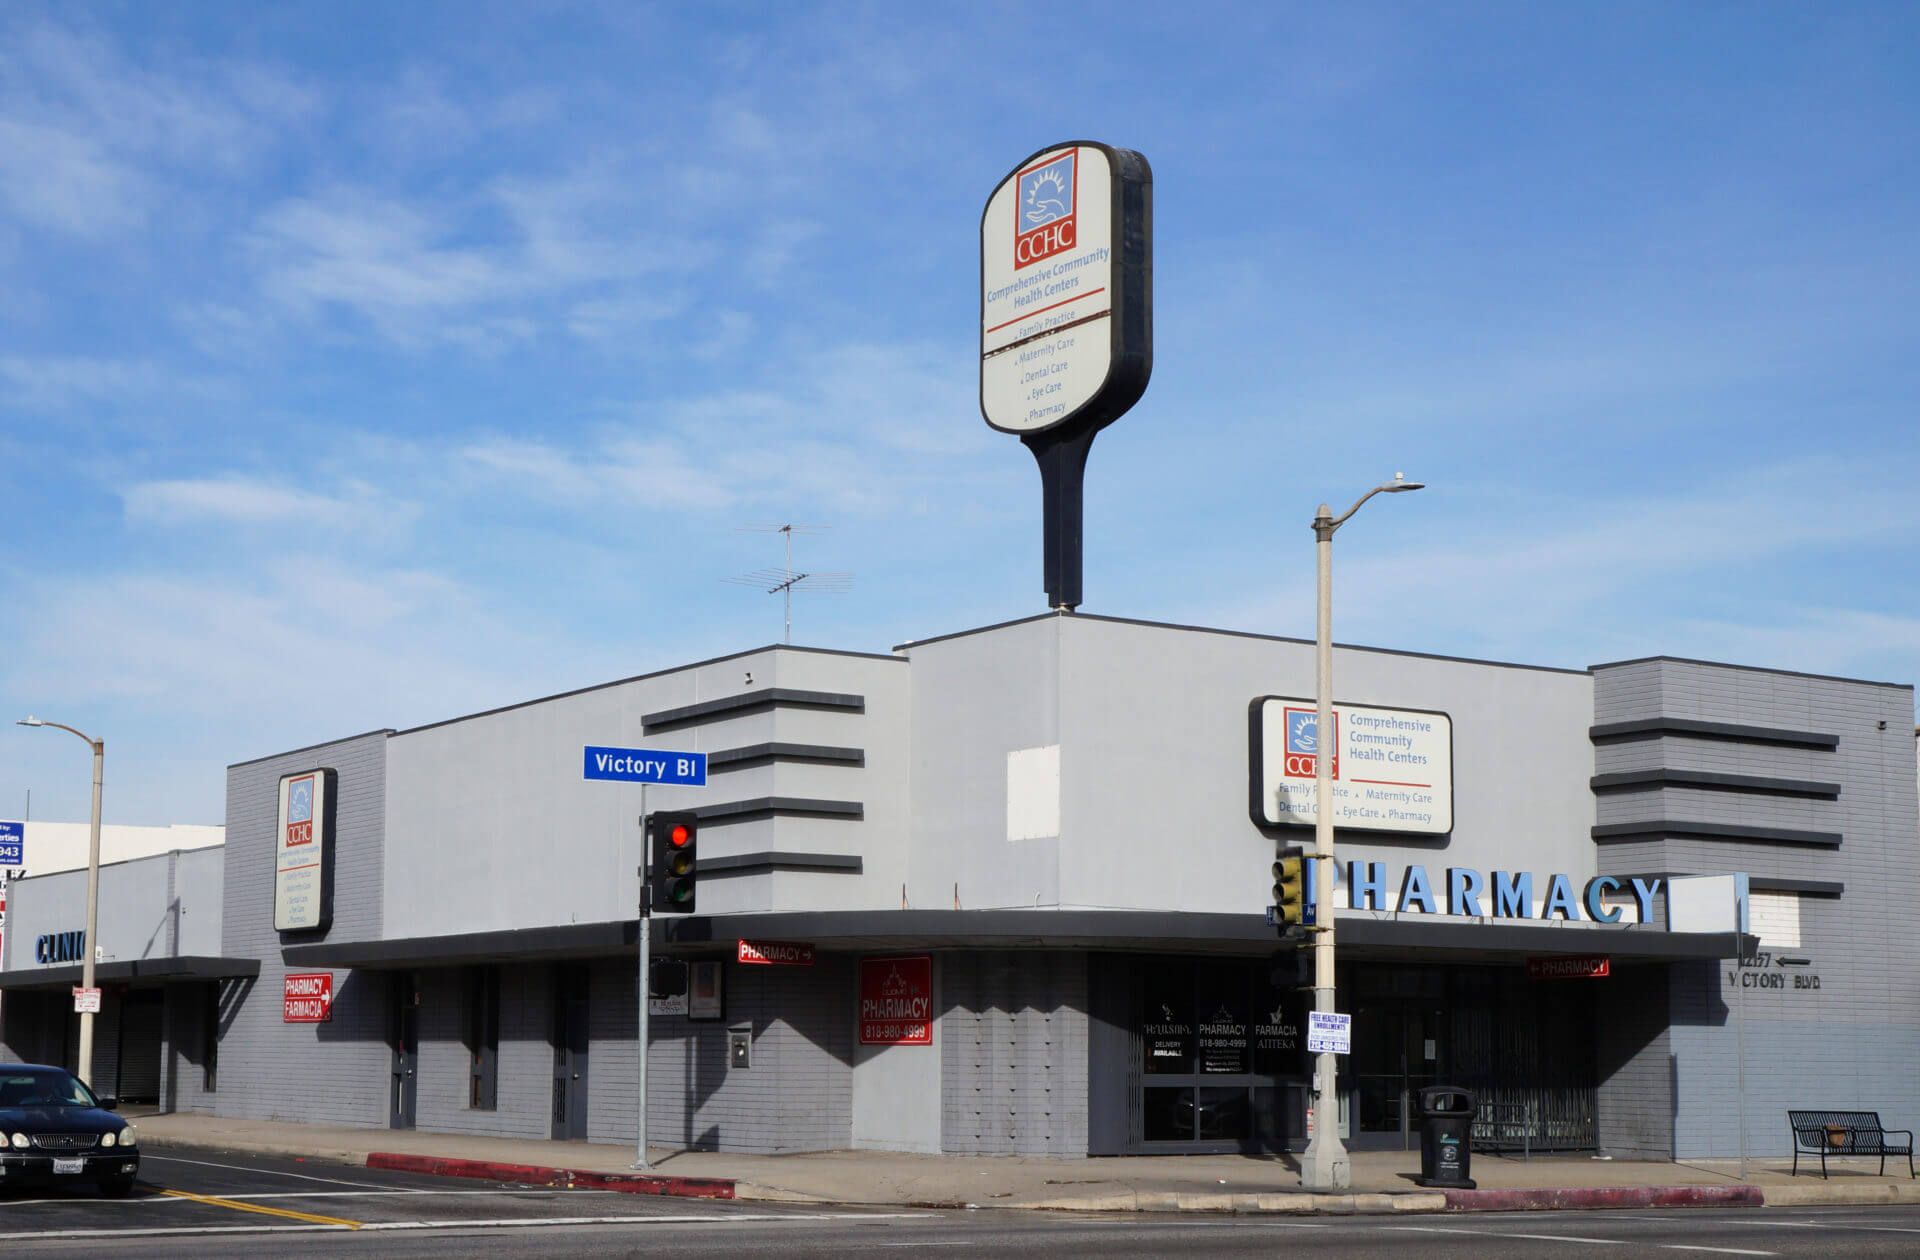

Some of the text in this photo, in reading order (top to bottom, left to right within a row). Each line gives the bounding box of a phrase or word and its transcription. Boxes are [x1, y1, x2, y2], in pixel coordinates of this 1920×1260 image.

[1017, 220, 1073, 263] CCHC
[987, 247, 1110, 303] Comprehensive Community
[1014, 276, 1080, 309] Health Centers
[1019, 310, 1075, 338] Family Practice
[1019, 337, 1075, 364] Maternity Care
[1025, 360, 1069, 382] Dental Care
[1032, 381, 1062, 401] Eye Care
[1029, 402, 1066, 421] Pharmacy
[1350, 713, 1431, 733] Comprehensive
[1350, 731, 1413, 750] Community
[595, 753, 666, 780] Victory
[1350, 748, 1428, 765] Health Centers
[1279, 782, 1433, 805] Family Ptice Maternity Care
[1279, 801, 1310, 814] Dental
[1343, 805, 1359, 819] Eye
[1359, 807, 1379, 818] Care
[1388, 808, 1432, 824] Pharmacy
[287, 823, 312, 844] CCHC
[741, 944, 800, 961] PHARMACY
[1542, 958, 1605, 975] PHARMACY
[285, 978, 323, 995] PHARMACY
[1728, 971, 1821, 989] VCTORY BLVD
[285, 1000, 323, 1017] FARMACIA
[863, 997, 929, 1018] PHARMACY
[866, 1024, 926, 1039] 818-980-4999
[1200, 1024, 1247, 1036] PHARMACY
[1255, 1025, 1298, 1036] FARMACIA
